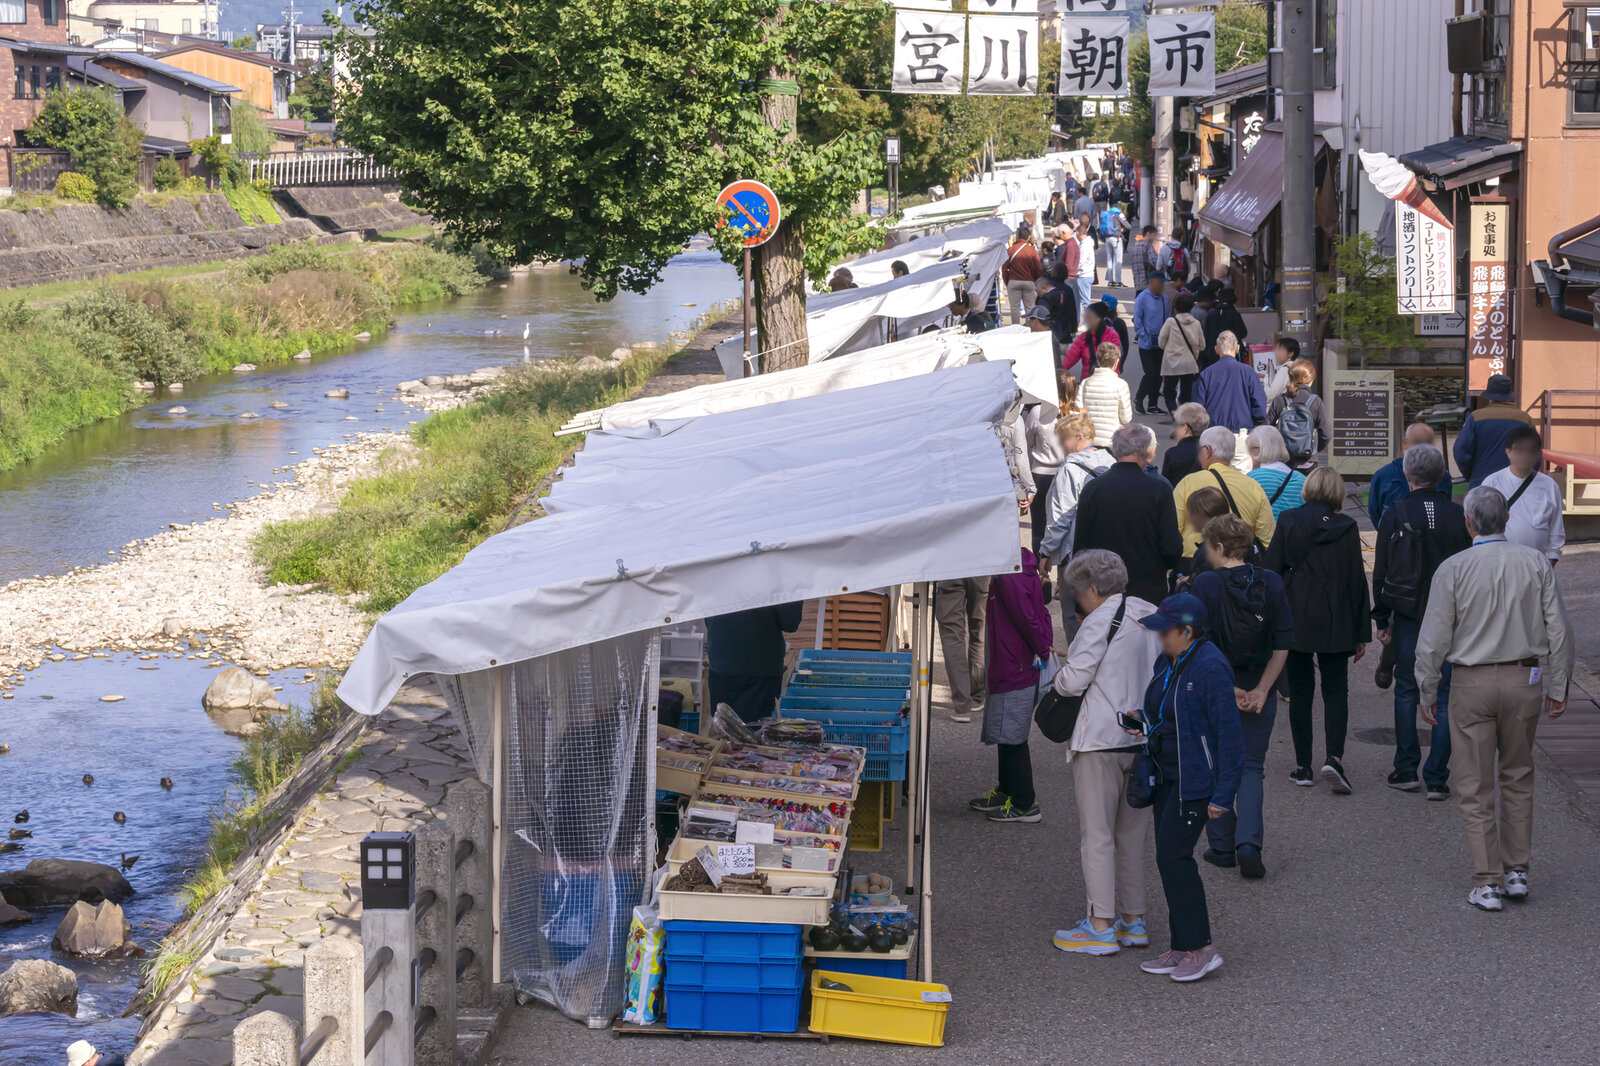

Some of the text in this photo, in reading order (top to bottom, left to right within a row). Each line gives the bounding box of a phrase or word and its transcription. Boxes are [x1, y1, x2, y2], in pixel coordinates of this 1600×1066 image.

[900, 23, 1211, 91] 宮川朝市
[1403, 211, 1416, 309] 地酒ソフトクリーム
[1425, 222, 1436, 308] コーヒーソフトクリーム
[1437, 231, 1447, 308] 桃ソフトクリーム
[1484, 211, 1496, 256] お食事処
[1472, 265, 1488, 355] 飛騨牛うどん
